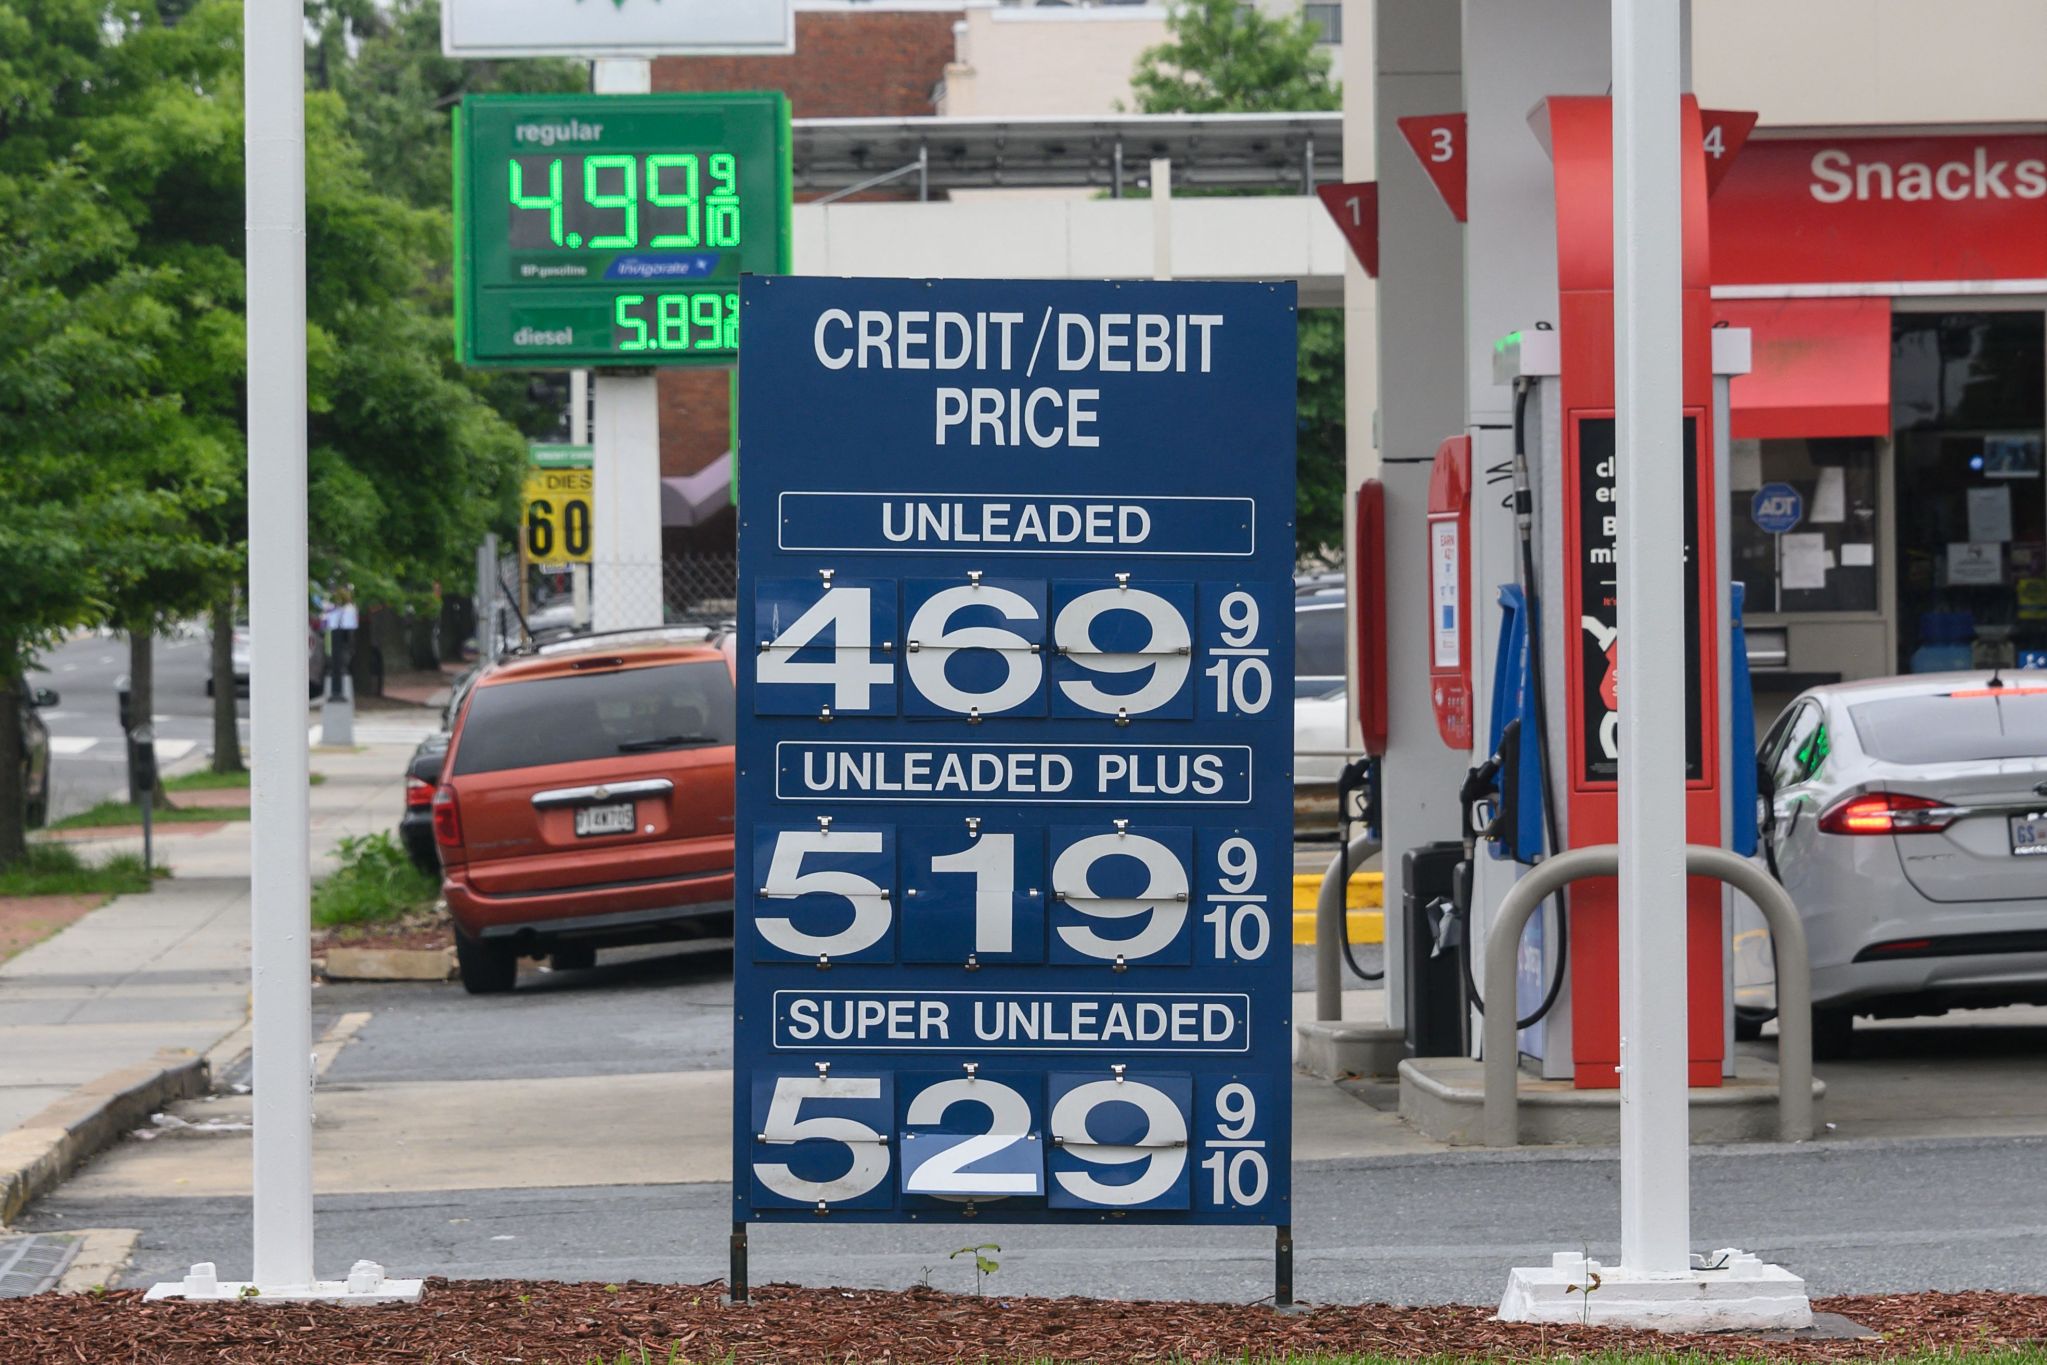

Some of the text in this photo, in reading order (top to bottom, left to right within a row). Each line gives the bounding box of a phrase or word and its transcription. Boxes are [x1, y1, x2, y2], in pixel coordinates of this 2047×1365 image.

[515, 119, 603, 146] regular
[1430, 127, 1453, 163] 3
[1702, 124, 1726, 159] 4
[1809, 146, 2047, 203] Snacks
[509, 153, 700, 249] 4.99
[1345, 196, 1361, 227] 1
[513, 326, 573, 346] diesel
[615, 293, 722, 351] 5.89
[814, 305, 1224, 378] CREDIT/DEBIT
[935, 386, 1101, 449] PRICE
[547, 474, 593, 490] DIES
[882, 502, 1152, 544] UNLEADED
[1757, 496, 1797, 516] ADT
[803, 751, 1224, 794] UNLEADED PLUS
[788, 999, 1236, 1043] SUPER UNLEADED
